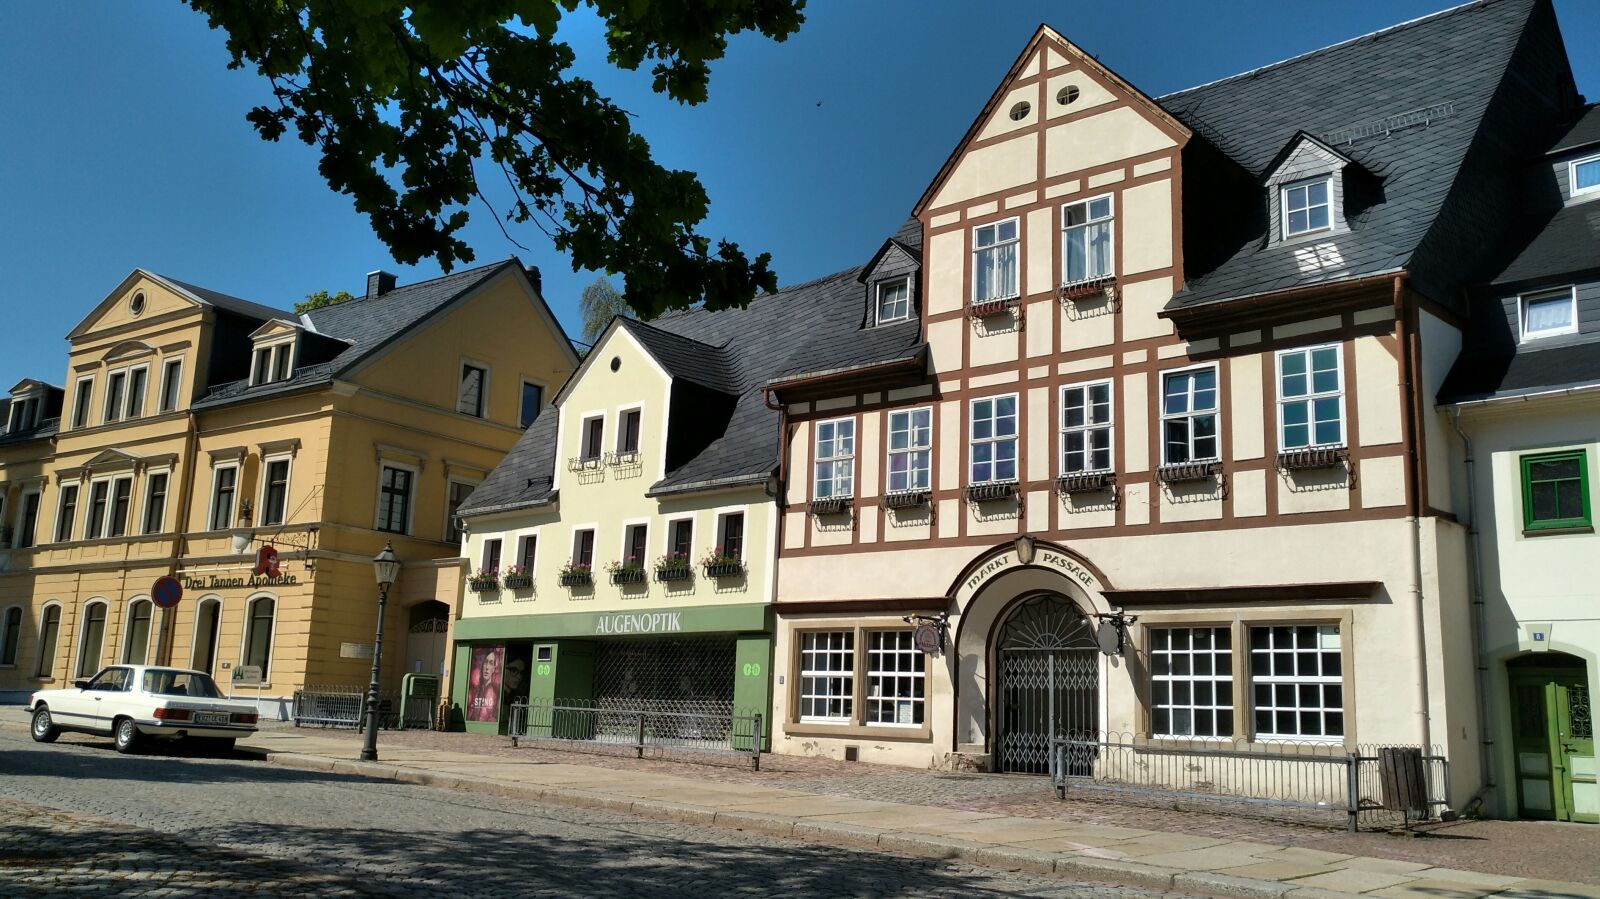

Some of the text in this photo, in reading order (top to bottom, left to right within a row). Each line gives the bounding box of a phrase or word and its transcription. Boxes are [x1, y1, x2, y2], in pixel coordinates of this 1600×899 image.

[967, 553, 1094, 589] MARKT PASSAGE
[184, 576, 206, 589] Drei
[209, 575, 243, 588] Tannen
[595, 612, 681, 633] AUGENOPTIK
